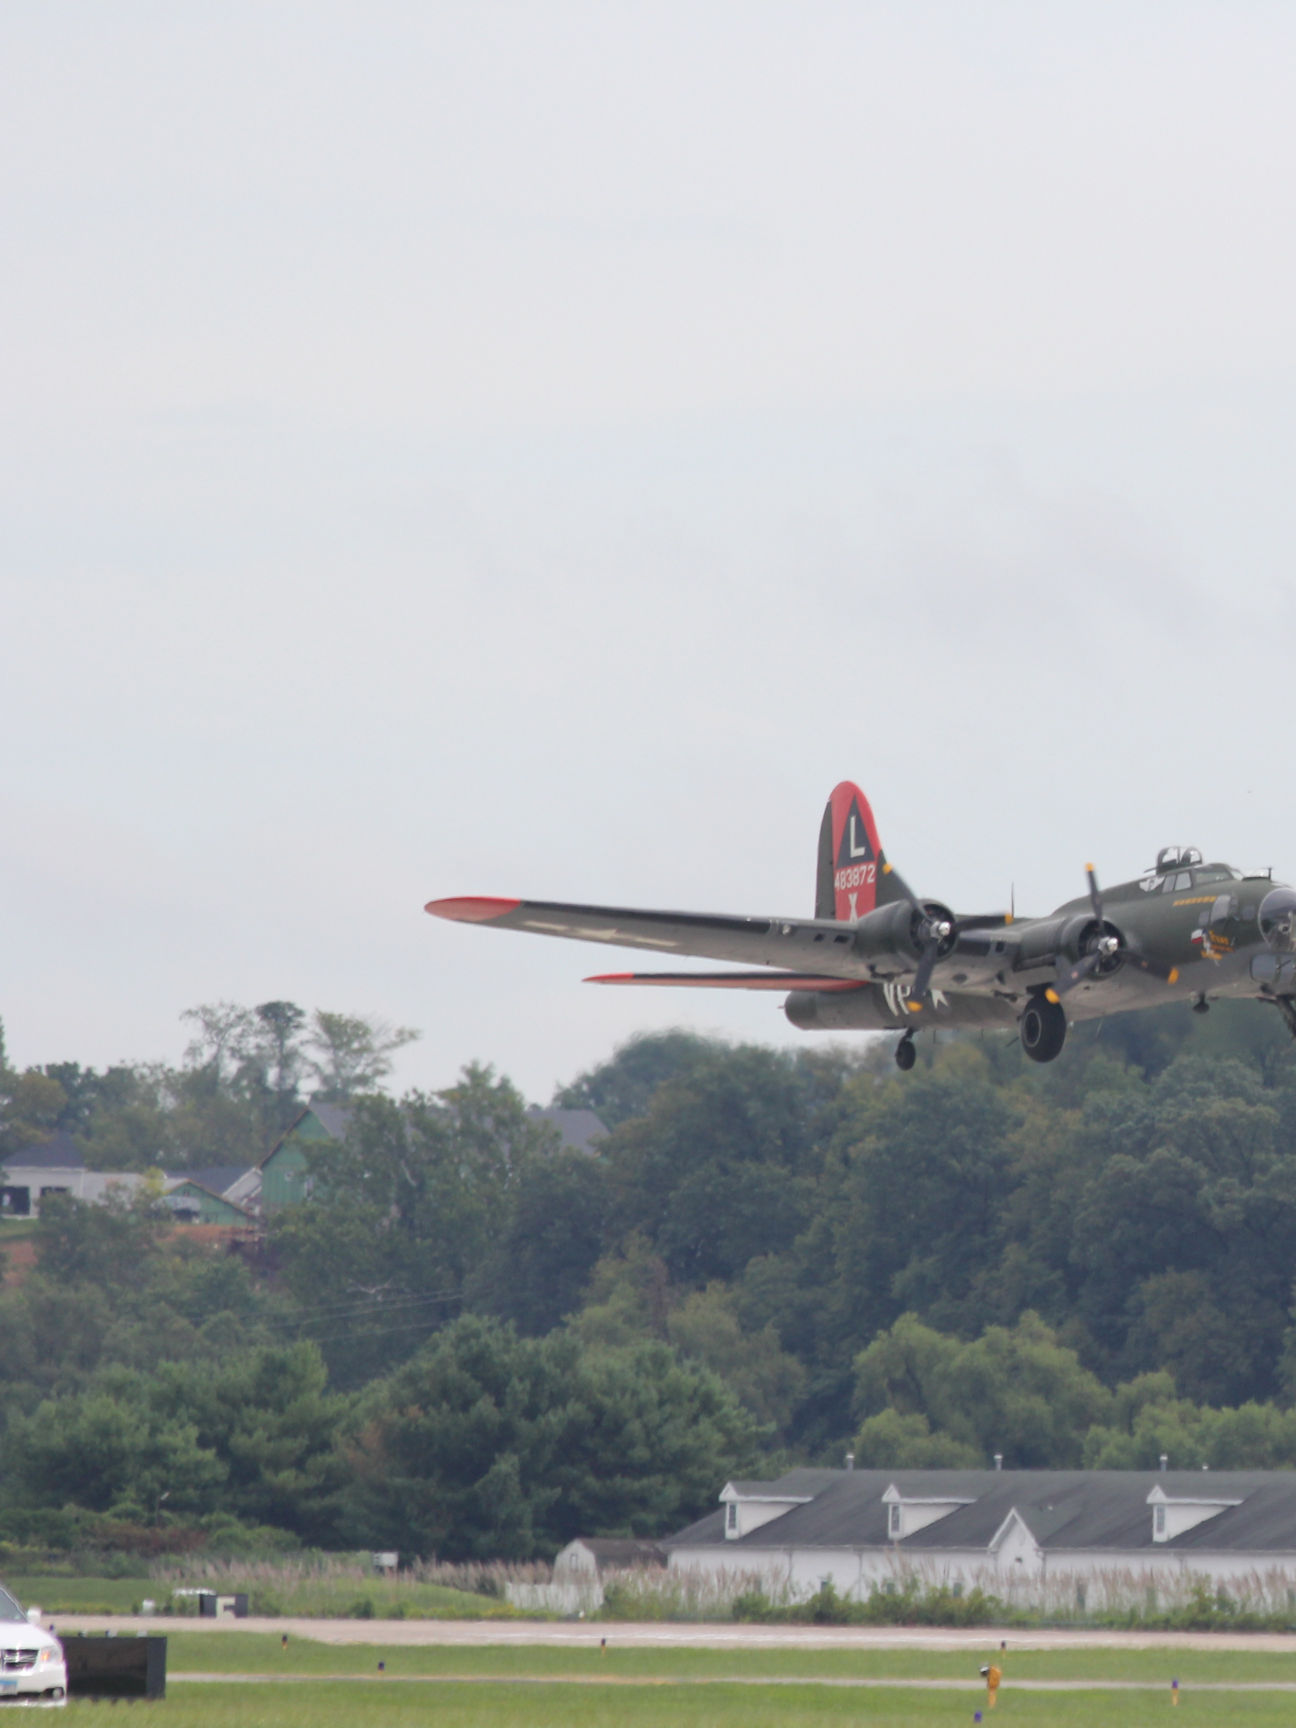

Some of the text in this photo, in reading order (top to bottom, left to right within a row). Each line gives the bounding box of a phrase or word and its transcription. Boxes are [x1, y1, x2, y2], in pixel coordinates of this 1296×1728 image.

[849, 816, 865, 858] L
[834, 864, 876, 890] 483872
[848, 892, 859, 923] X
